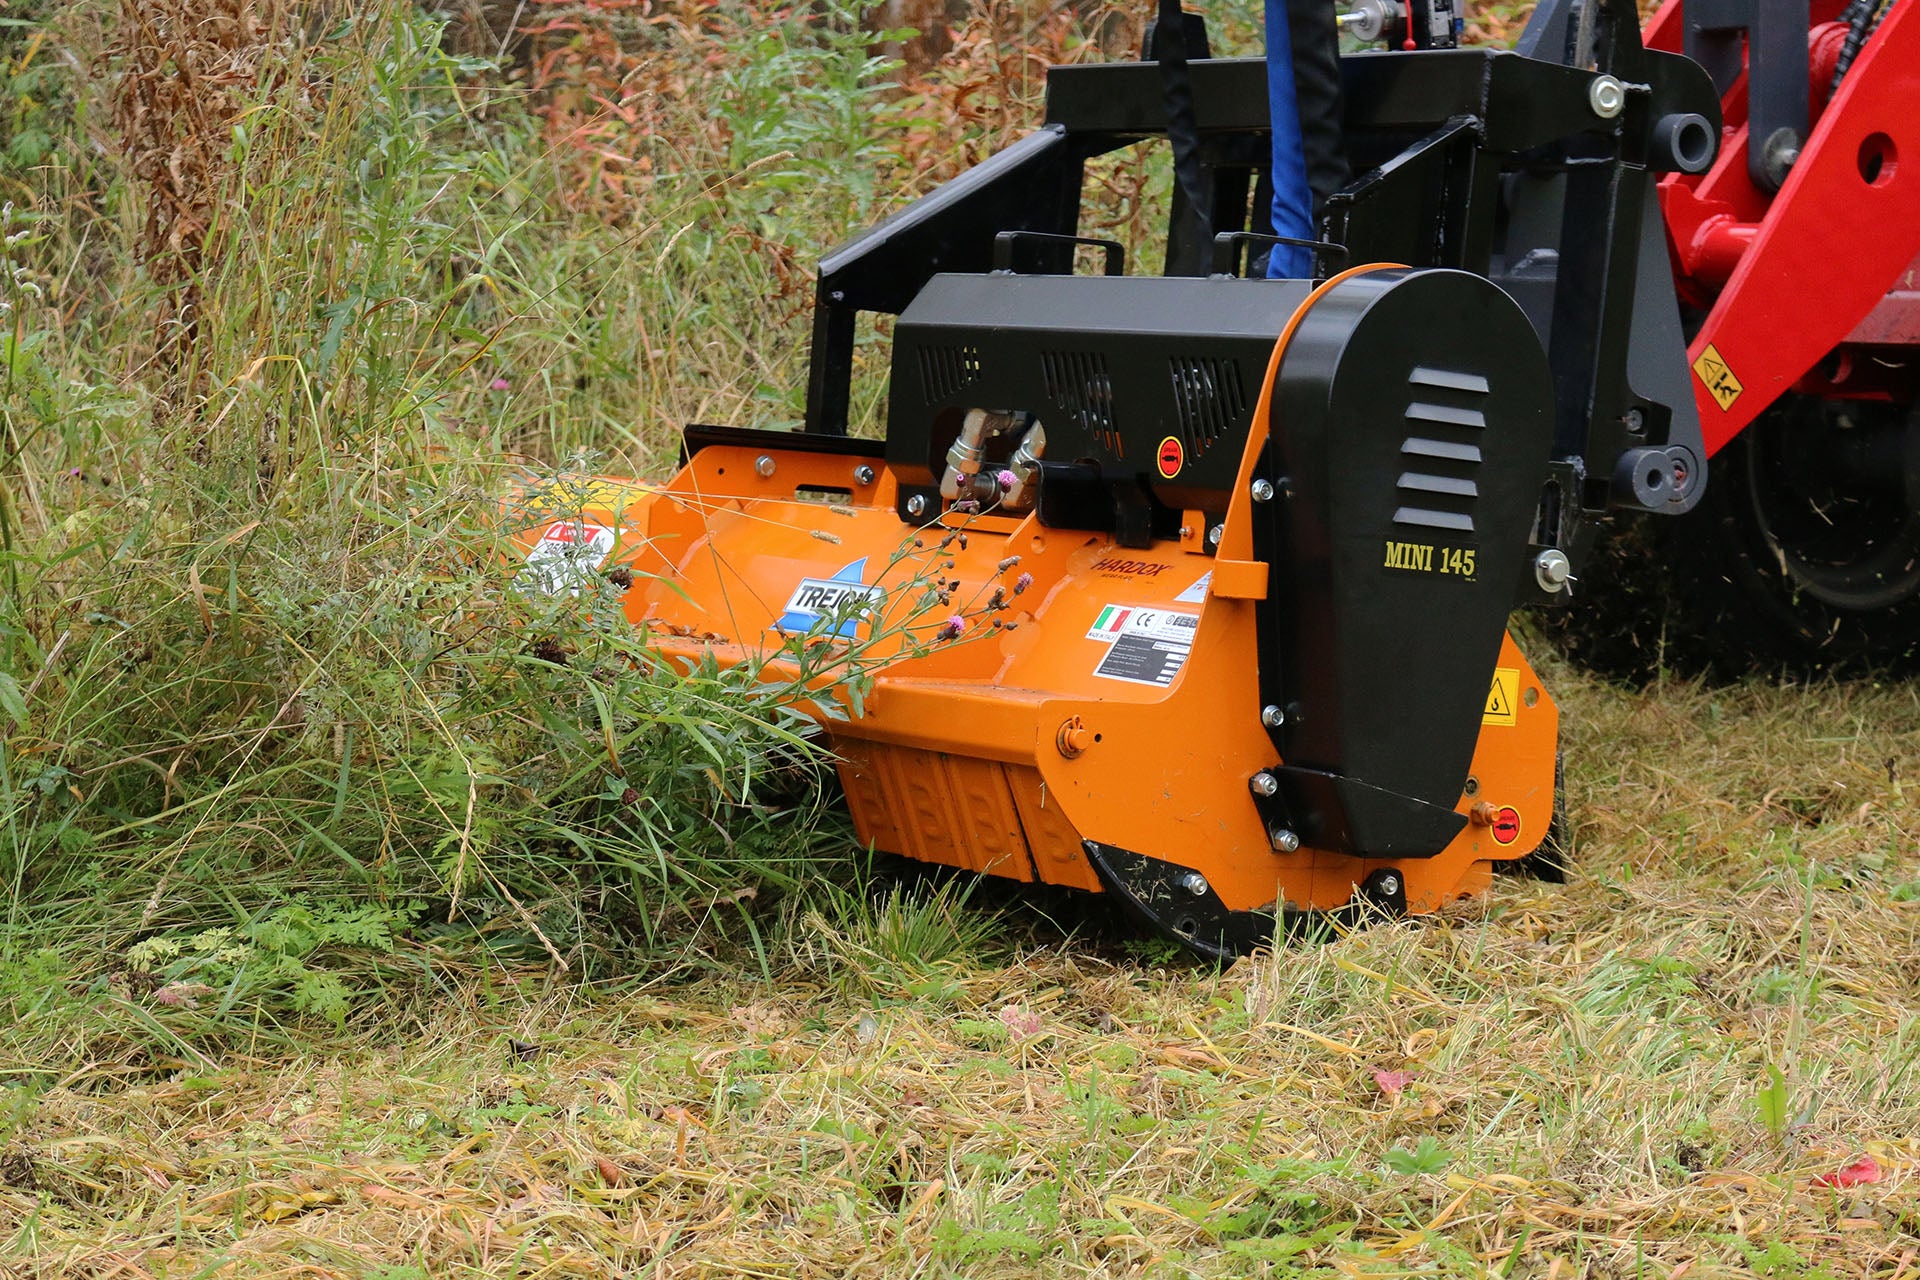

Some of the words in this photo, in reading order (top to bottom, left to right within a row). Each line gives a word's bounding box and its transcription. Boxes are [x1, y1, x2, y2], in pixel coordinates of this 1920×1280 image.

[1090, 558, 1169, 577] HARDOX
[1384, 541, 1434, 571] MINI
[1440, 547, 1475, 576] 145
